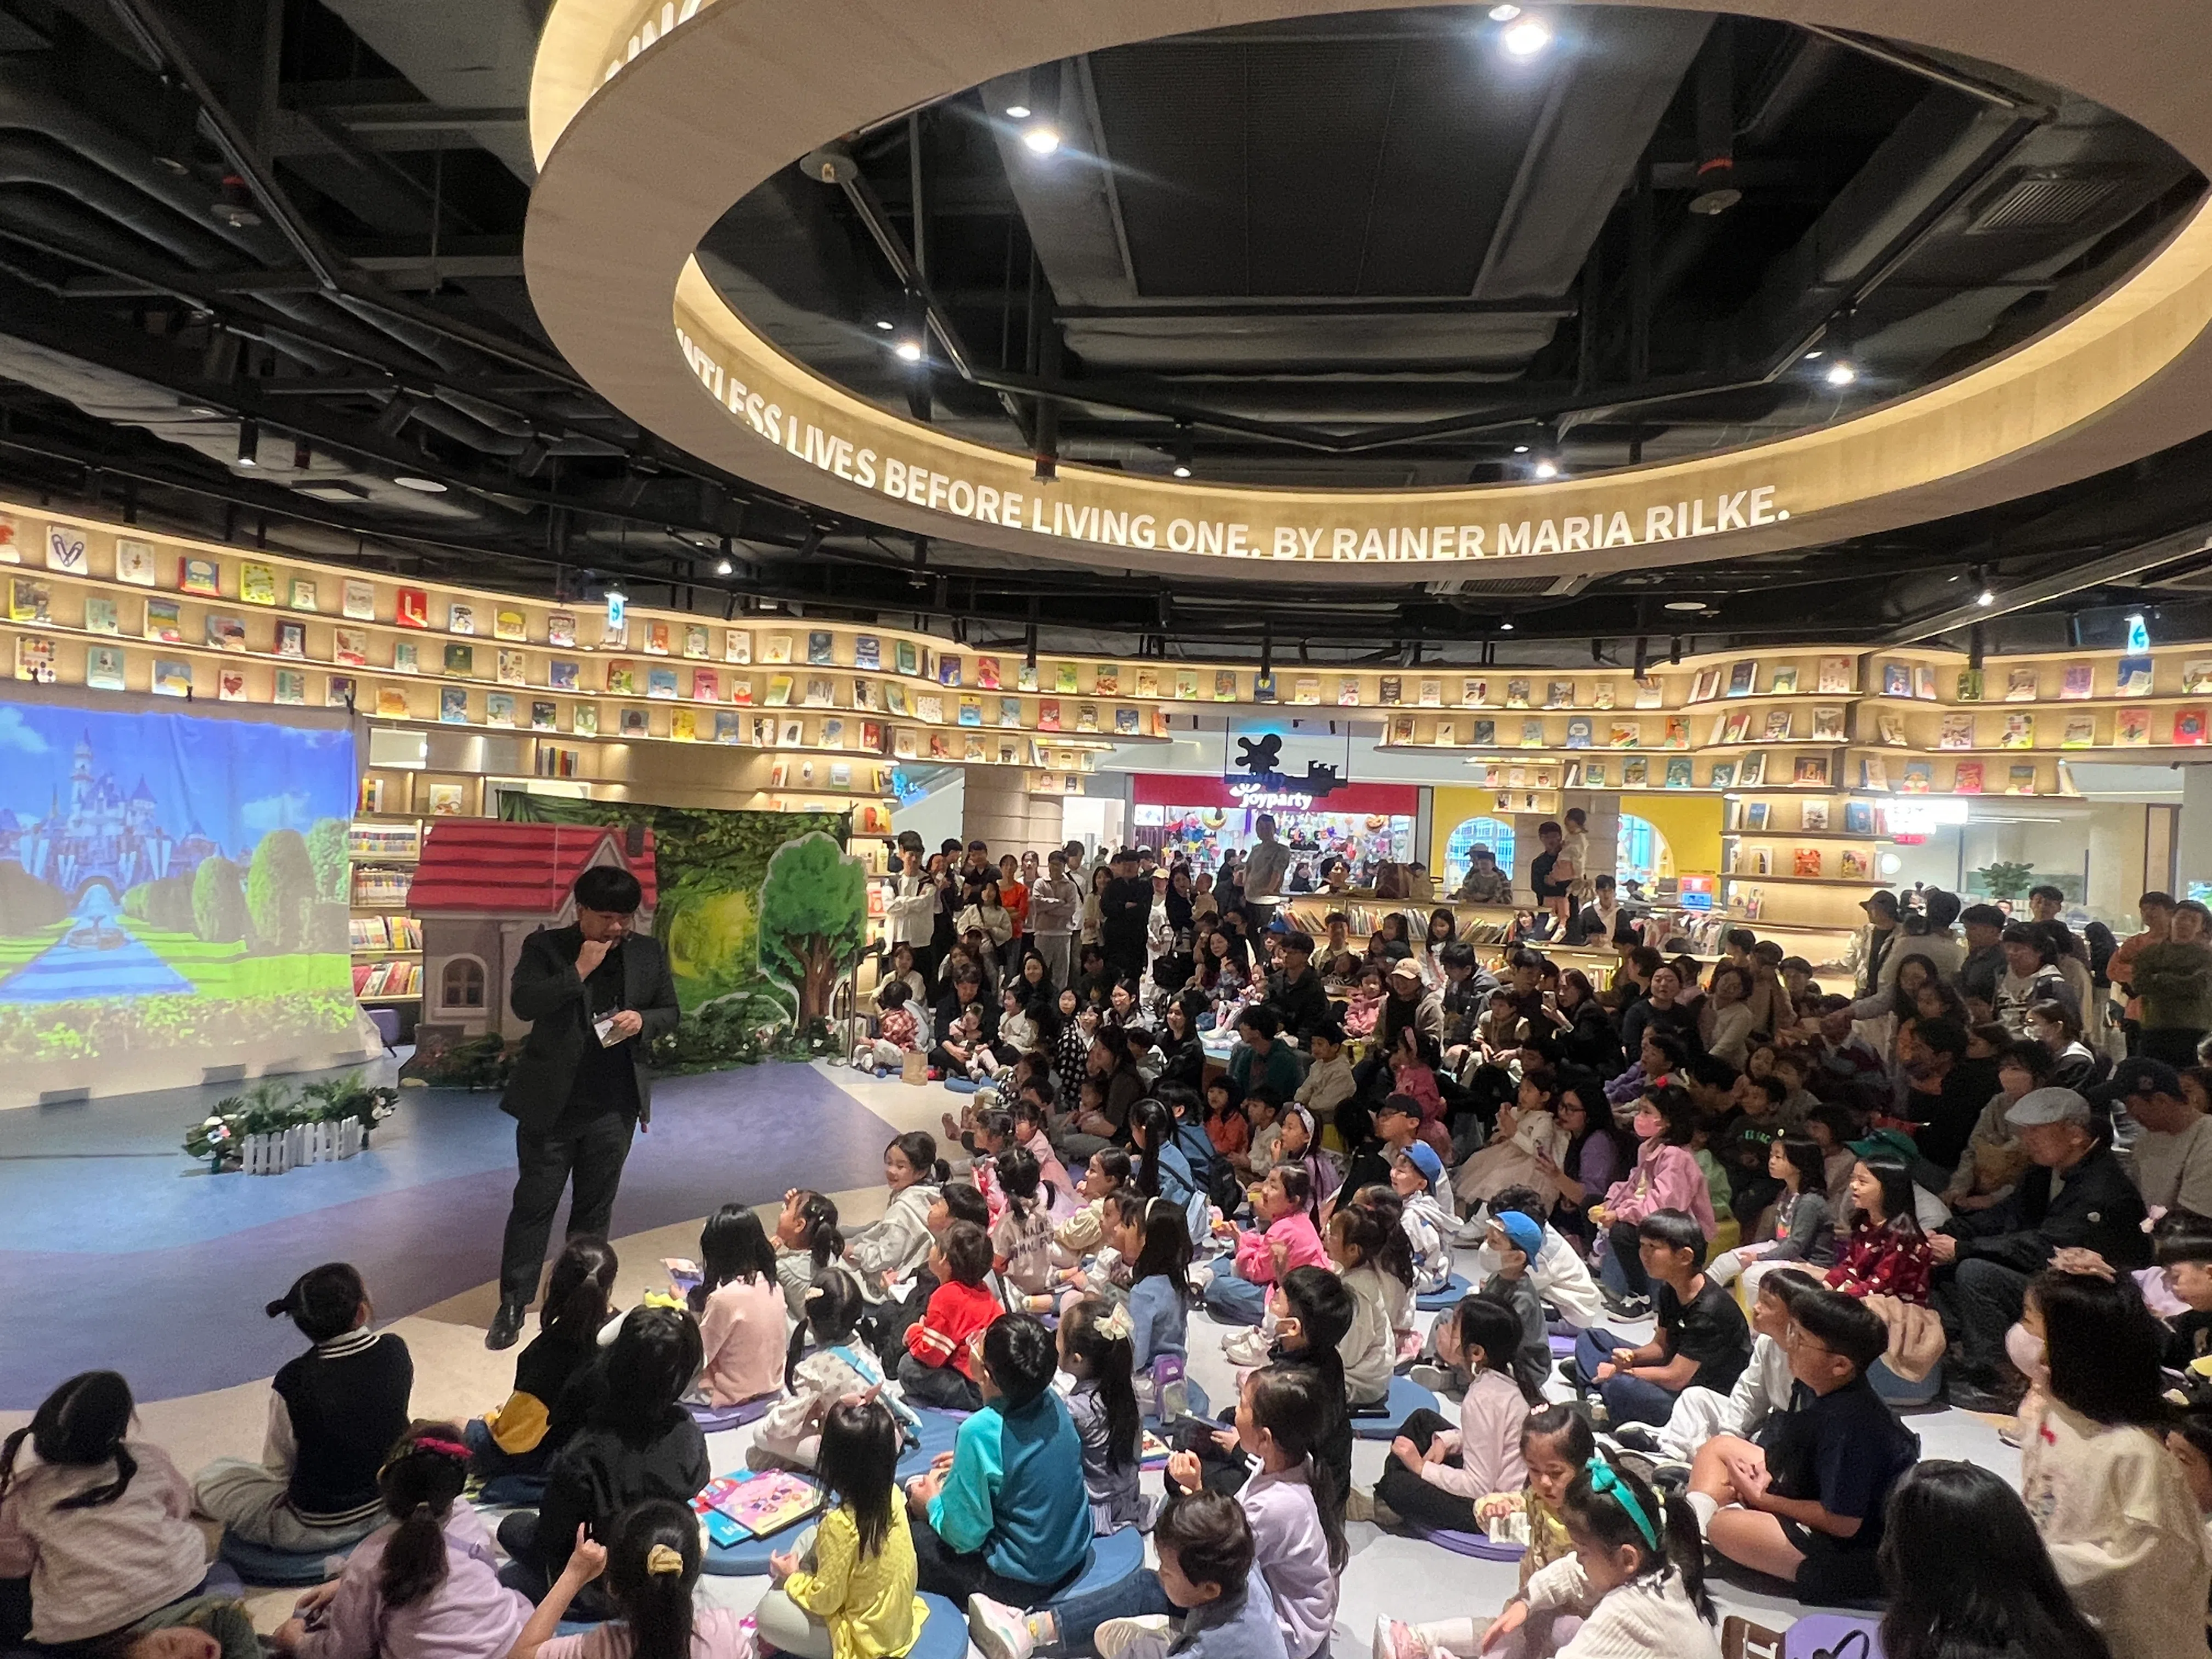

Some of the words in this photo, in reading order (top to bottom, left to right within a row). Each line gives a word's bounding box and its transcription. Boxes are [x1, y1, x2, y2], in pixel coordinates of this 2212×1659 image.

[786, 415, 877, 488] LIVES
[884, 458, 1024, 529] BEFORE
[1032, 498, 1155, 548] LIVING
[1166, 518, 1261, 558] ONE.
[1273, 527, 1323, 560] BY
[1332, 525, 1484, 561] RAINER
[1497, 511, 1634, 555] MARIA
[1646, 484, 1790, 542] RILKE.
